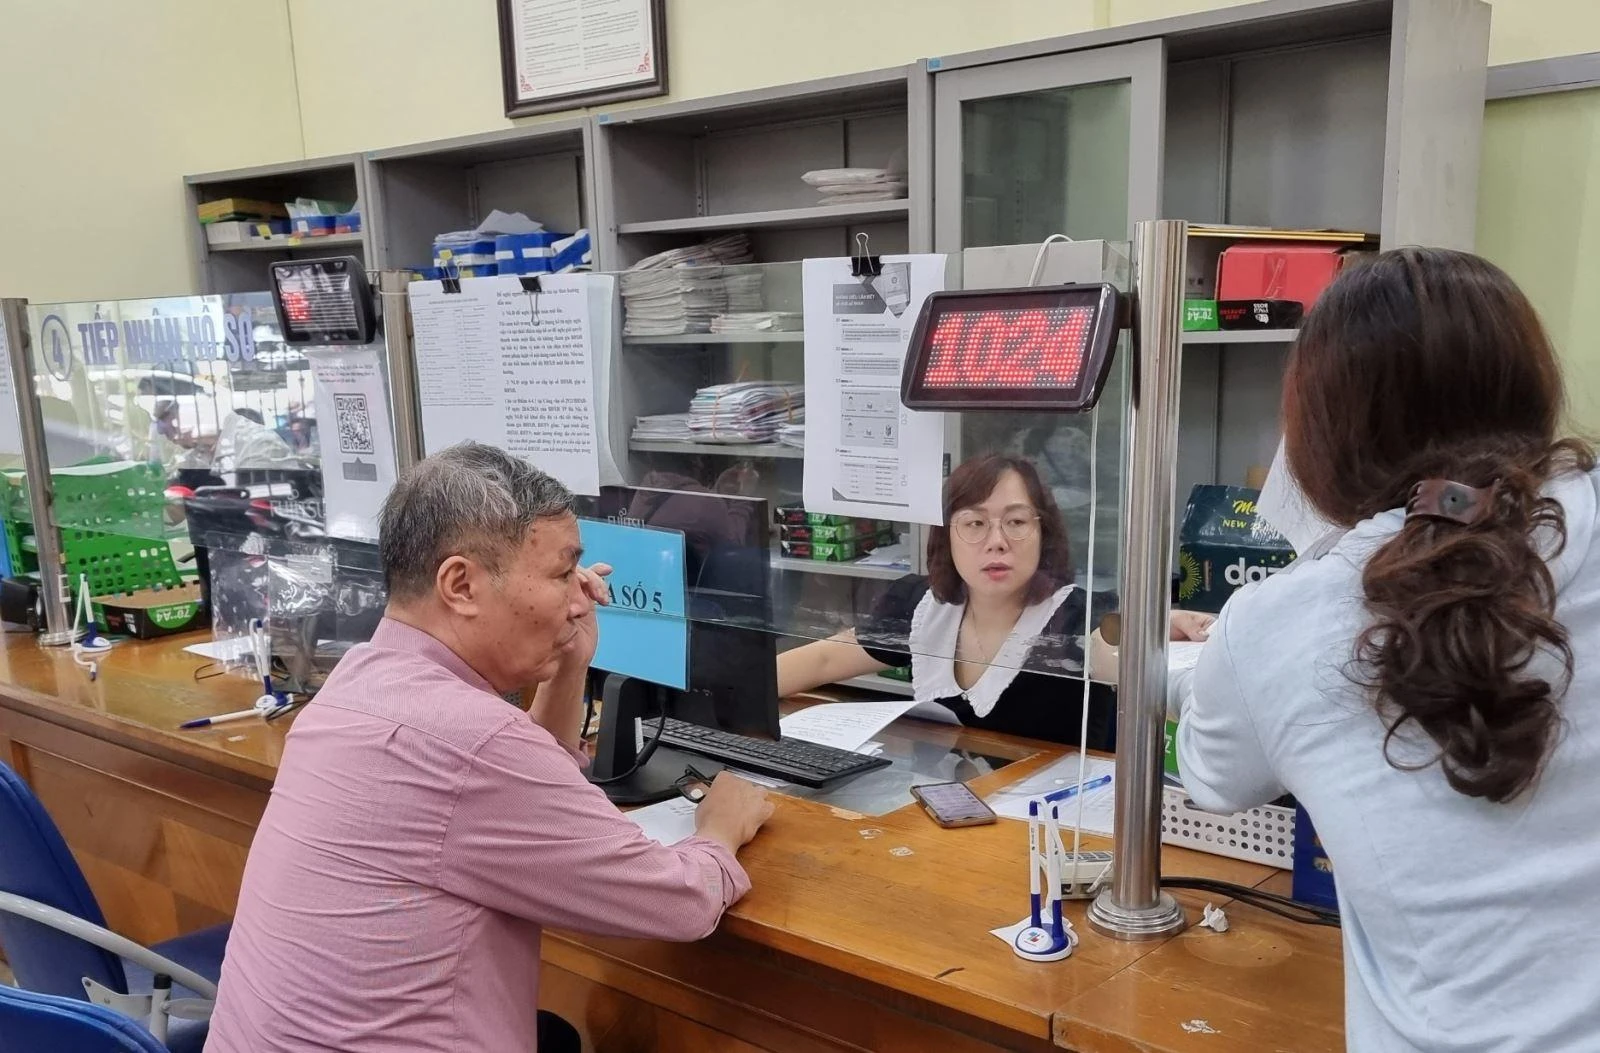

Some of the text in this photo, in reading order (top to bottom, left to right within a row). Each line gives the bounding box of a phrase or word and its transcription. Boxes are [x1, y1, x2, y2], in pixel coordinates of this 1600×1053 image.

[51, 329, 66, 369] 4
[78, 304, 120, 365] TIẾP
[186, 296, 217, 362] HỒ
[928, 310, 1086, 384] 1024
[1232, 499, 1259, 515] Ma
[1222, 518, 1247, 530] NEW
[1224, 557, 1284, 585] da
[621, 581, 647, 609] SỐ
[652, 591, 662, 612] 5
